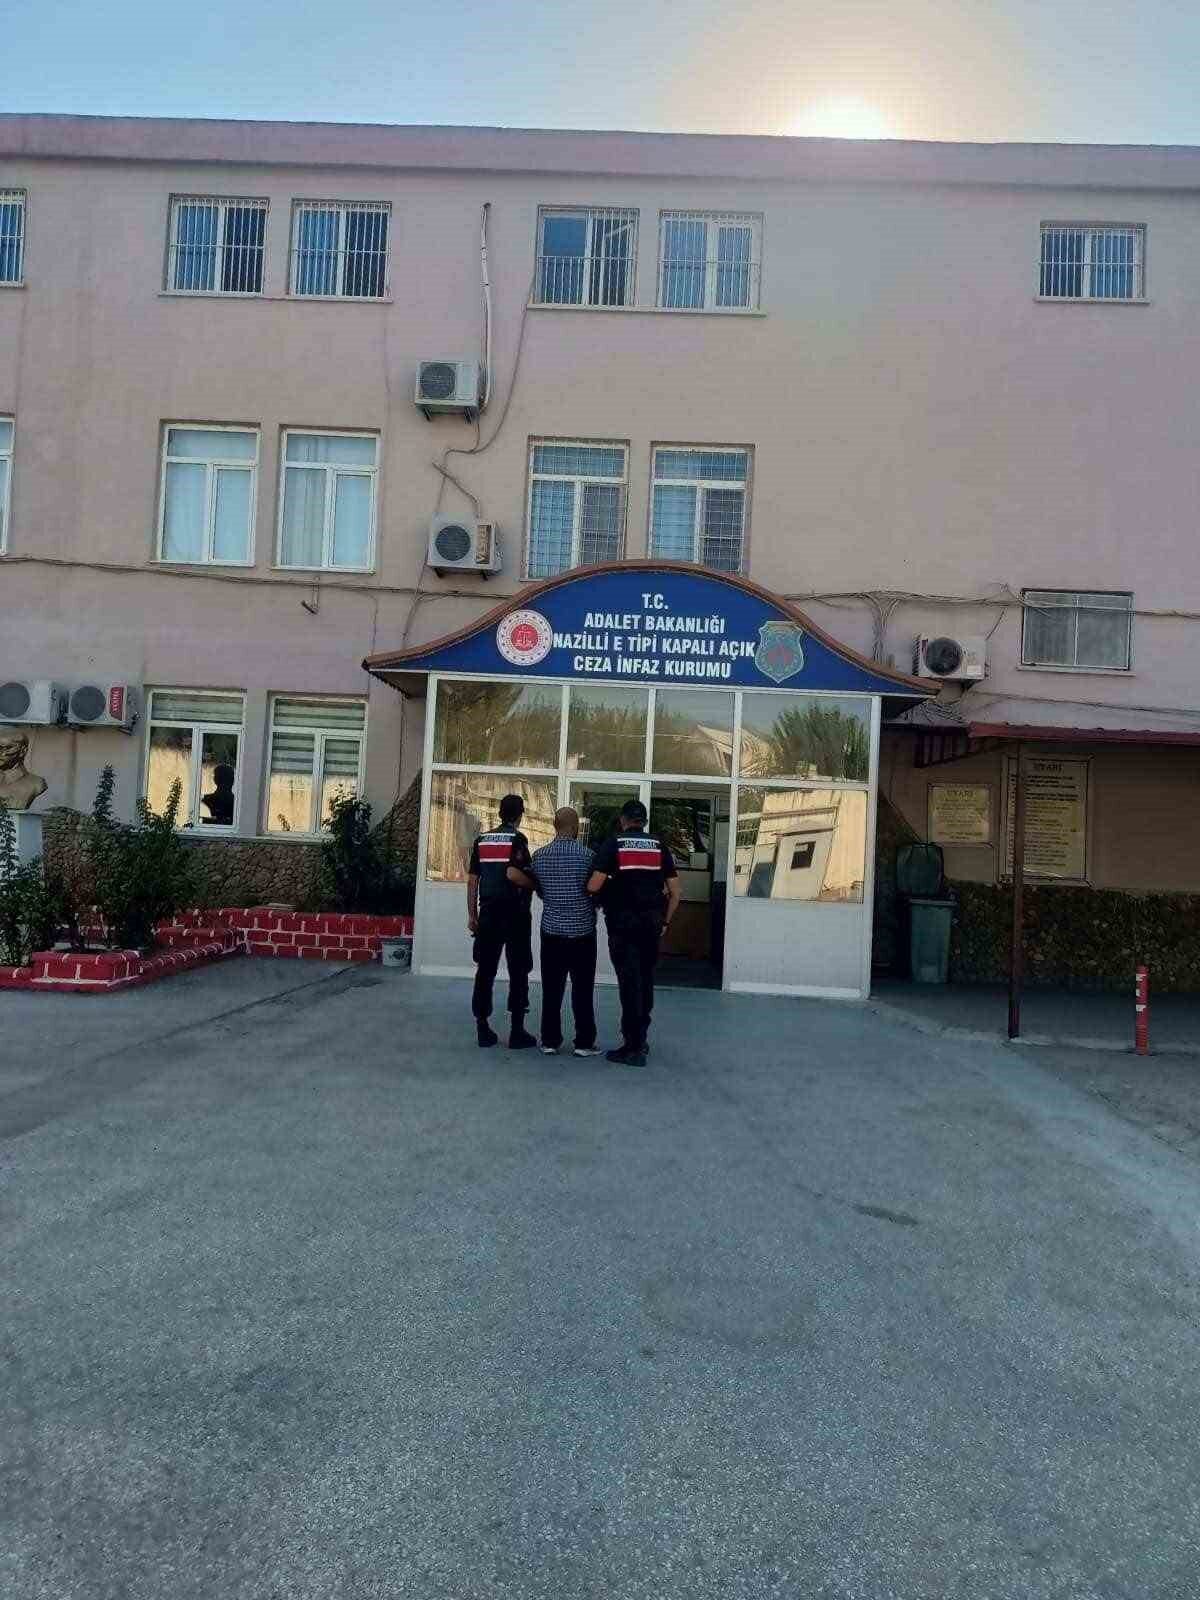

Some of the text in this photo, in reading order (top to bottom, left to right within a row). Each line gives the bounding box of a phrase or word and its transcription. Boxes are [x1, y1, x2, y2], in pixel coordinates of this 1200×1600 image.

[642, 593, 669, 610] T.C.
[584, 612, 725, 634] ADALET BAKANLIĞI
[553, 631, 756, 660] NAZİLLİ E TİPİ KAPALI AÇIK
[573, 654, 731, 678] CEZA İNFAZ KURUMU
